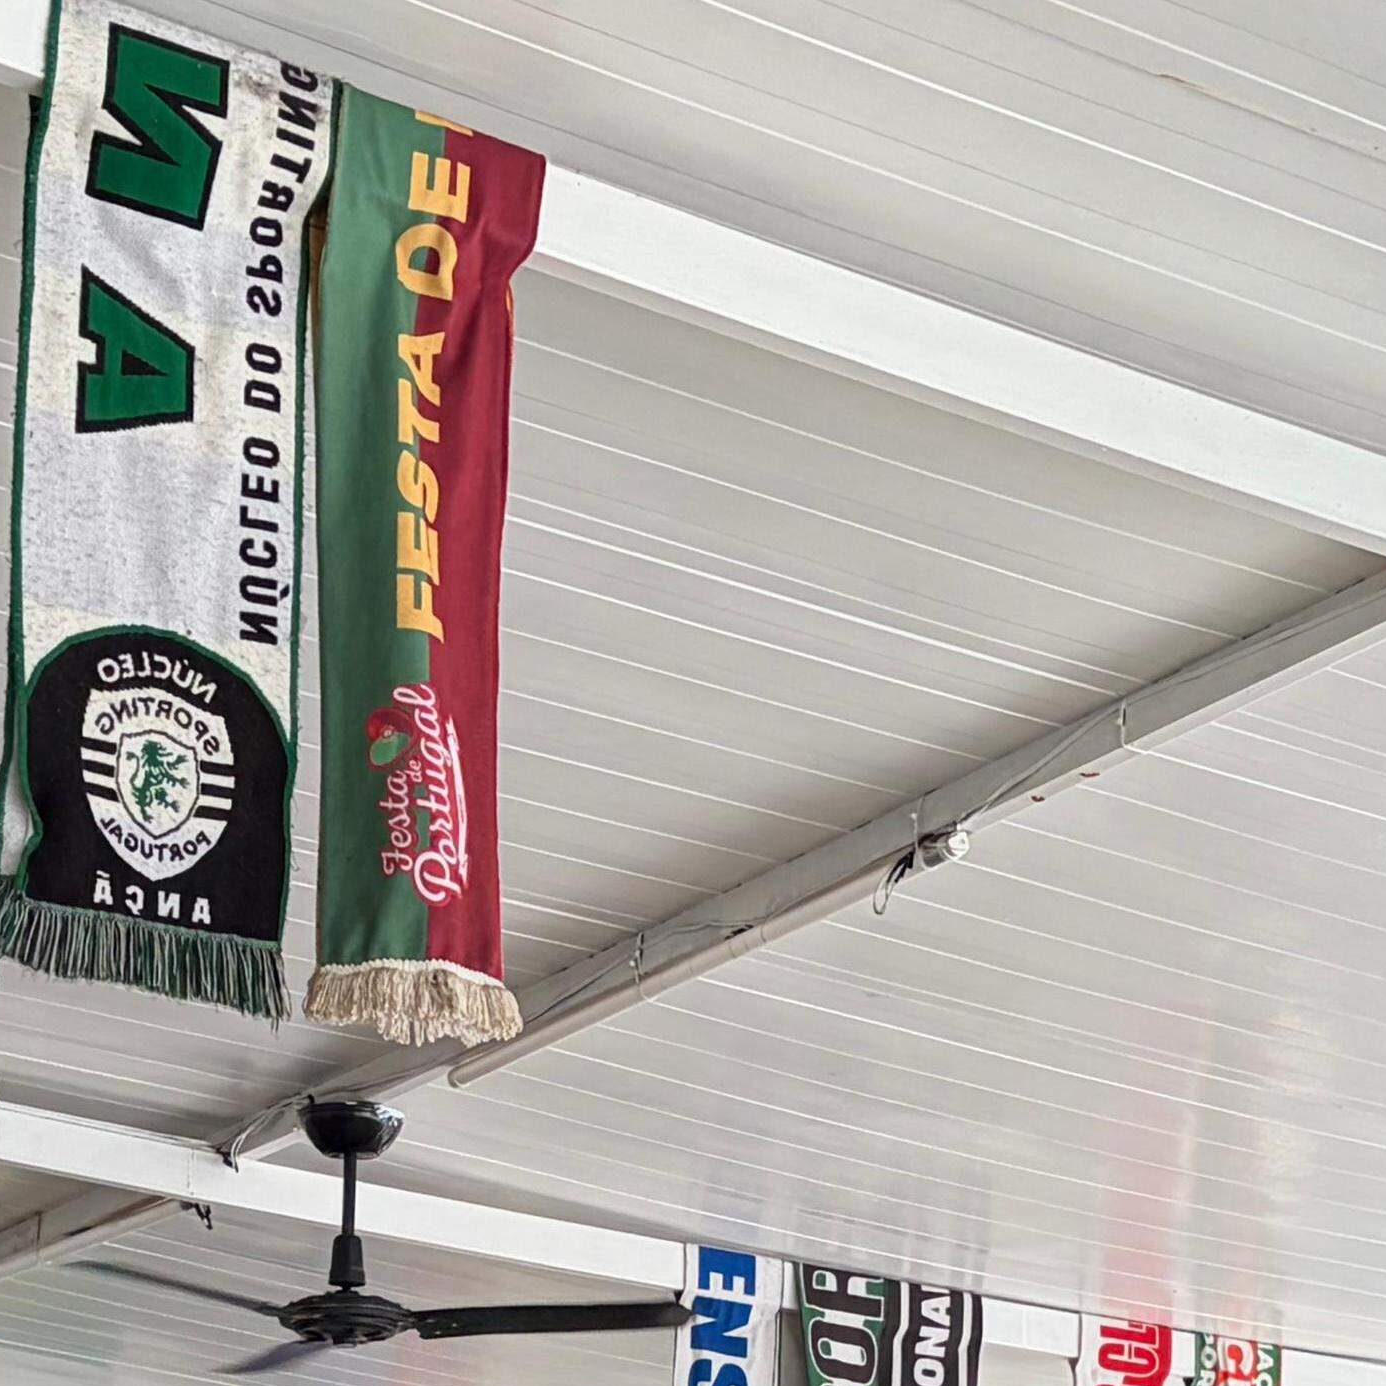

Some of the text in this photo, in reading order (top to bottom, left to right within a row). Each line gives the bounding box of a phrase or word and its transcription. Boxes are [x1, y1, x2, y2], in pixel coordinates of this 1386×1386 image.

[395, 151, 472, 301] DE
[395, 331, 446, 644] FESTA
[381, 766, 410, 878] Festa
[393, 682, 465, 904] Portugal
[405, 757, 423, 784] de
